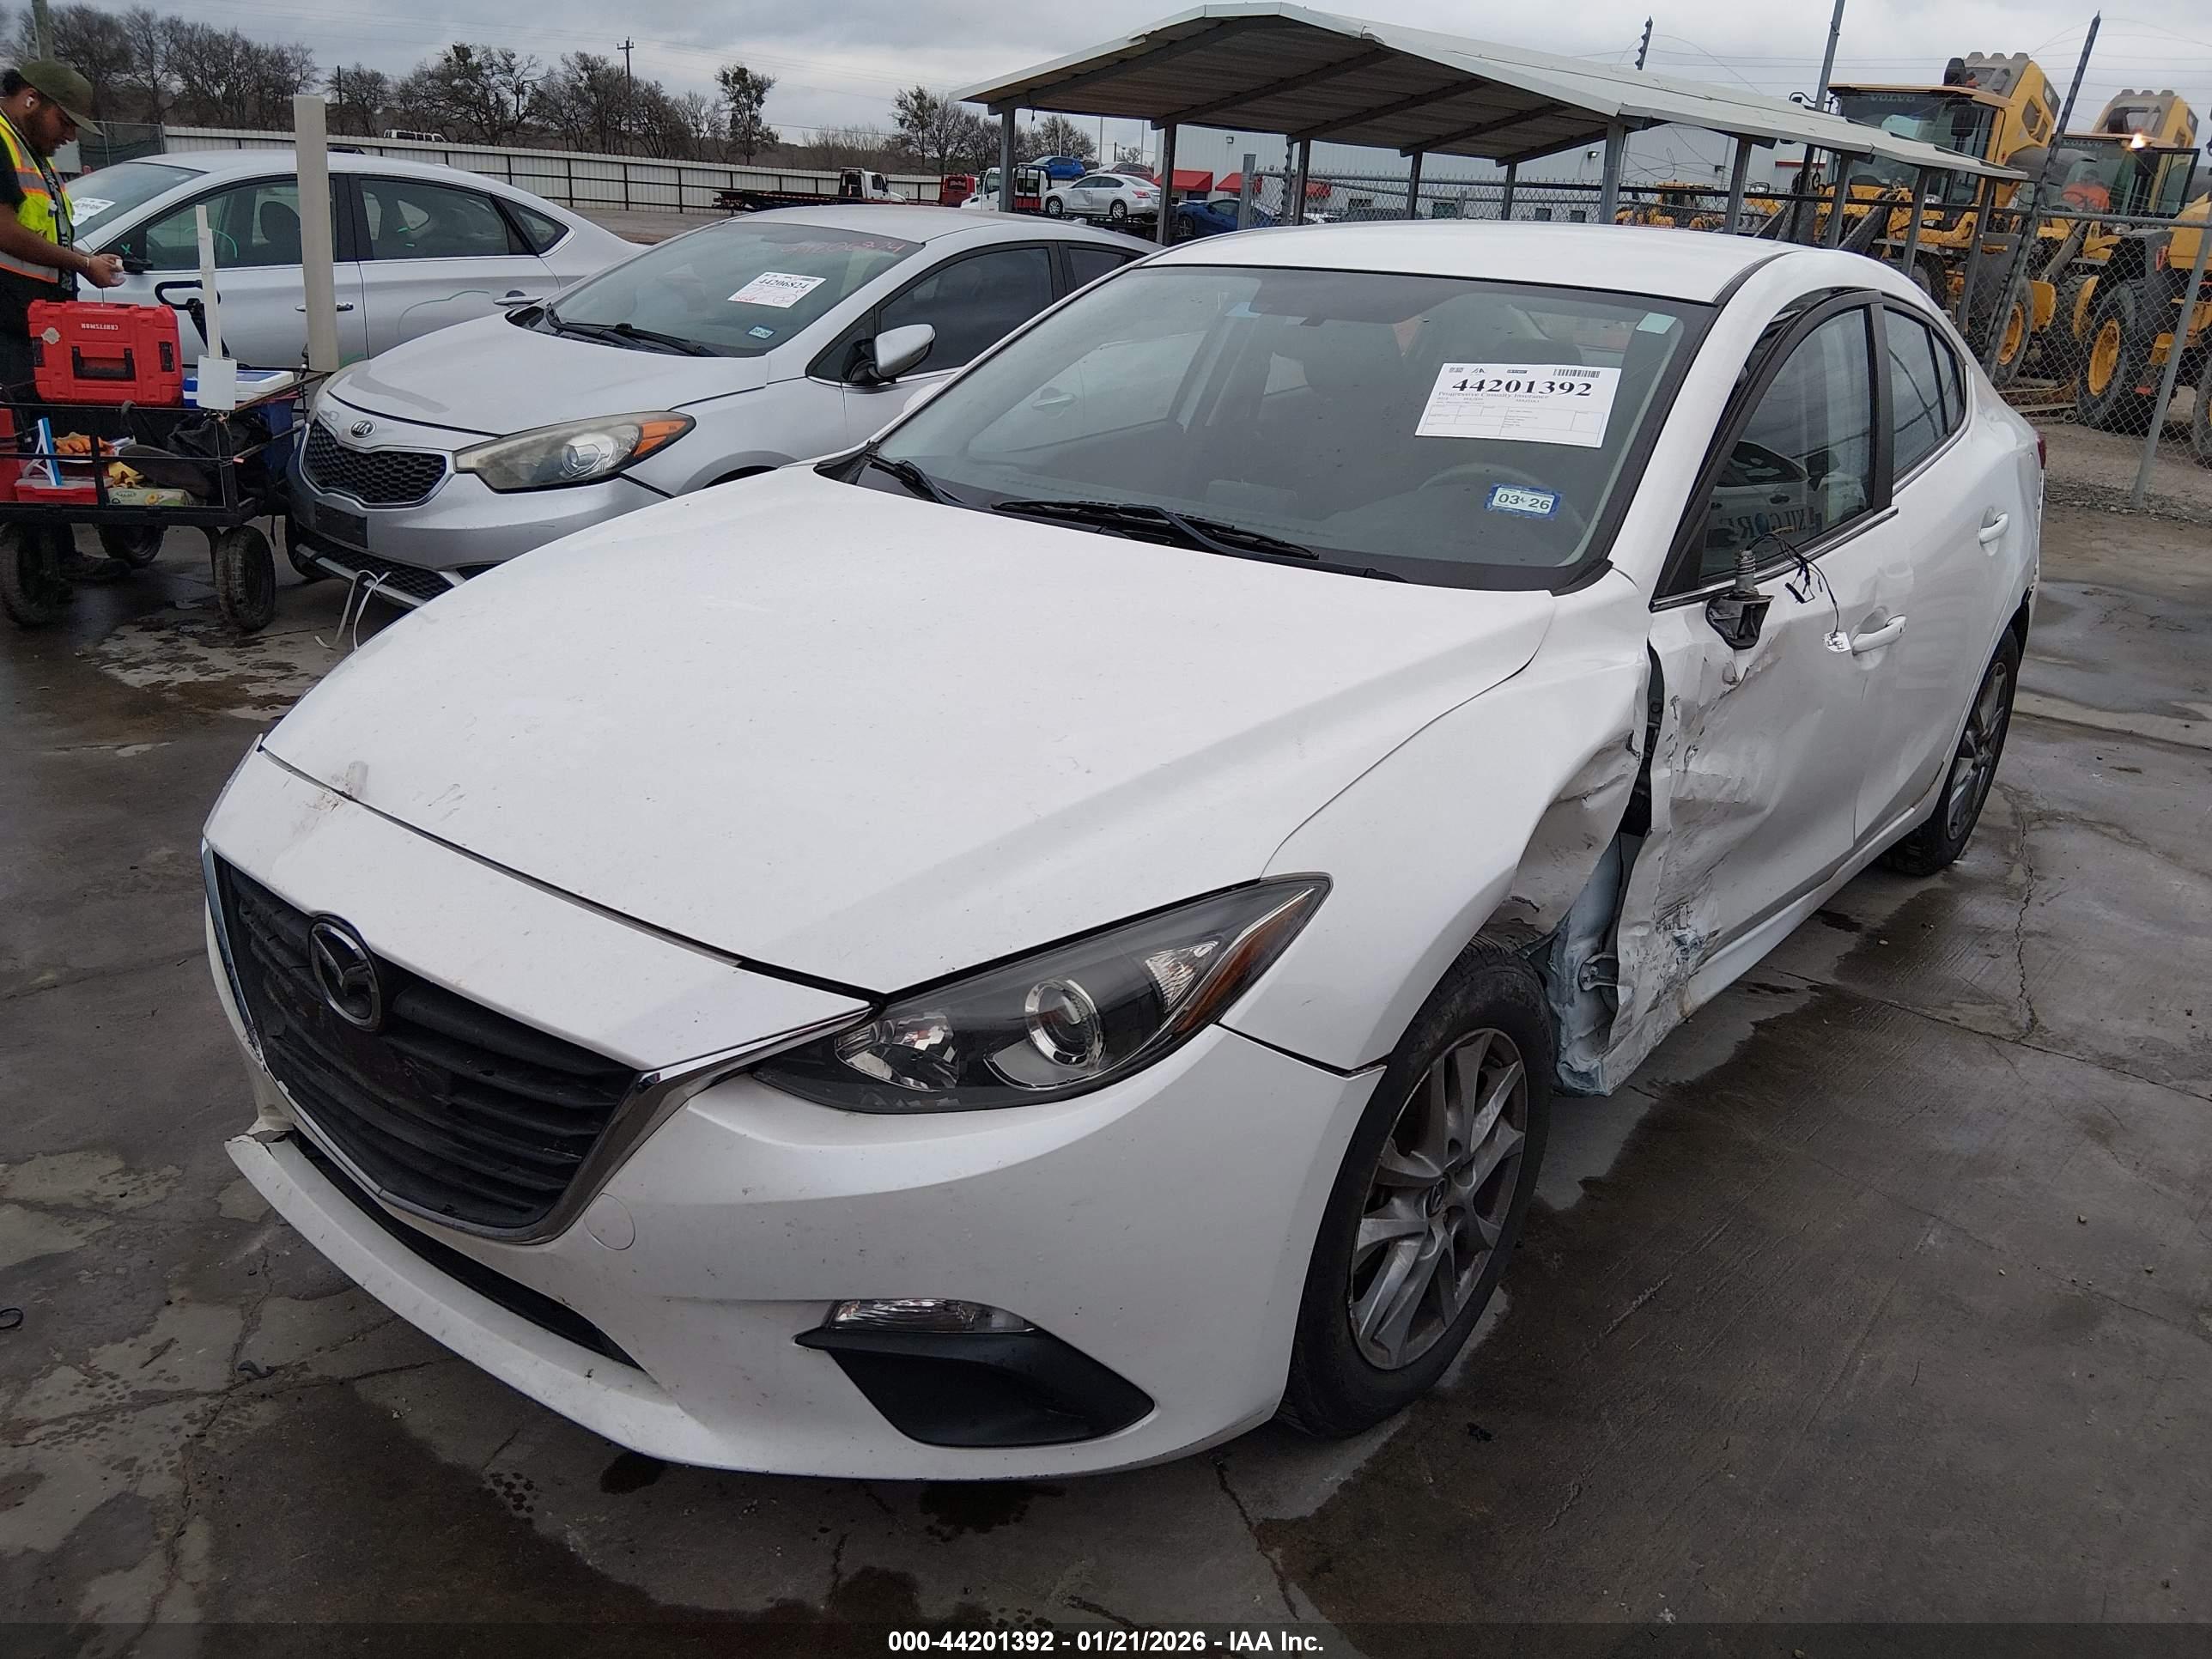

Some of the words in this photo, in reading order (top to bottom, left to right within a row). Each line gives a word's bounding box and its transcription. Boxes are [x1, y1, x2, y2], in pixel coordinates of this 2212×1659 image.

[1869, 94, 1916, 103] VOLVO
[2063, 139, 2103, 148] VOLVO
[1452, 378, 1593, 397] 44201392
[1498, 493, 1520, 505] 03
[1528, 498, 1551, 510] 26
